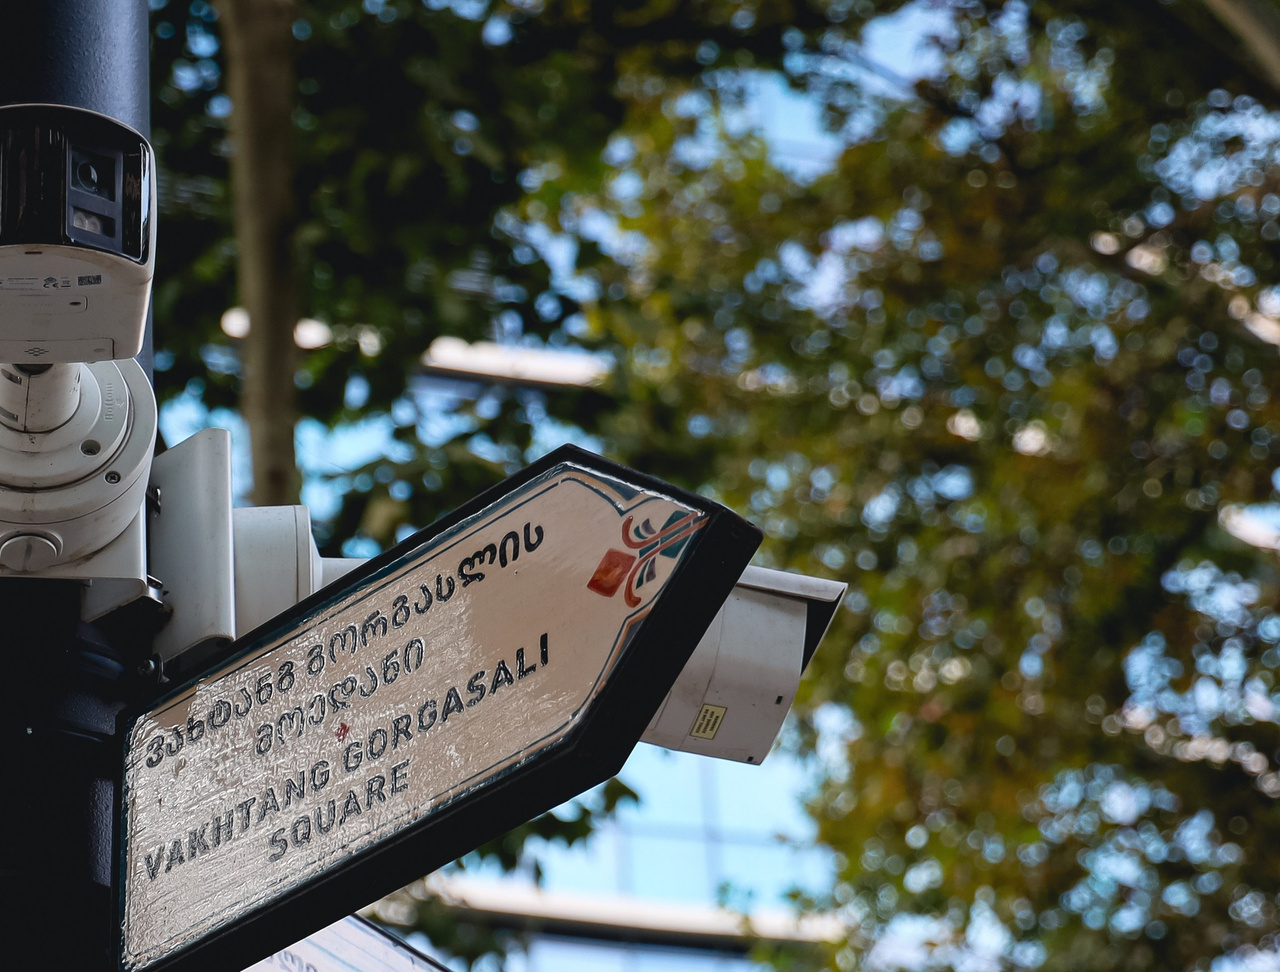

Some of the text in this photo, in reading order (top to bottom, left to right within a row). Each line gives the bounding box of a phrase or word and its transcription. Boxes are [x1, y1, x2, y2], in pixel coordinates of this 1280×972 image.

[146, 522, 545, 769] ვახტანგ გორგასლის
[256, 638, 426, 757] მოედანი
[143, 633, 550, 882] VAKHTANG GORGASALI
[268, 759, 411, 863] SQUARE
